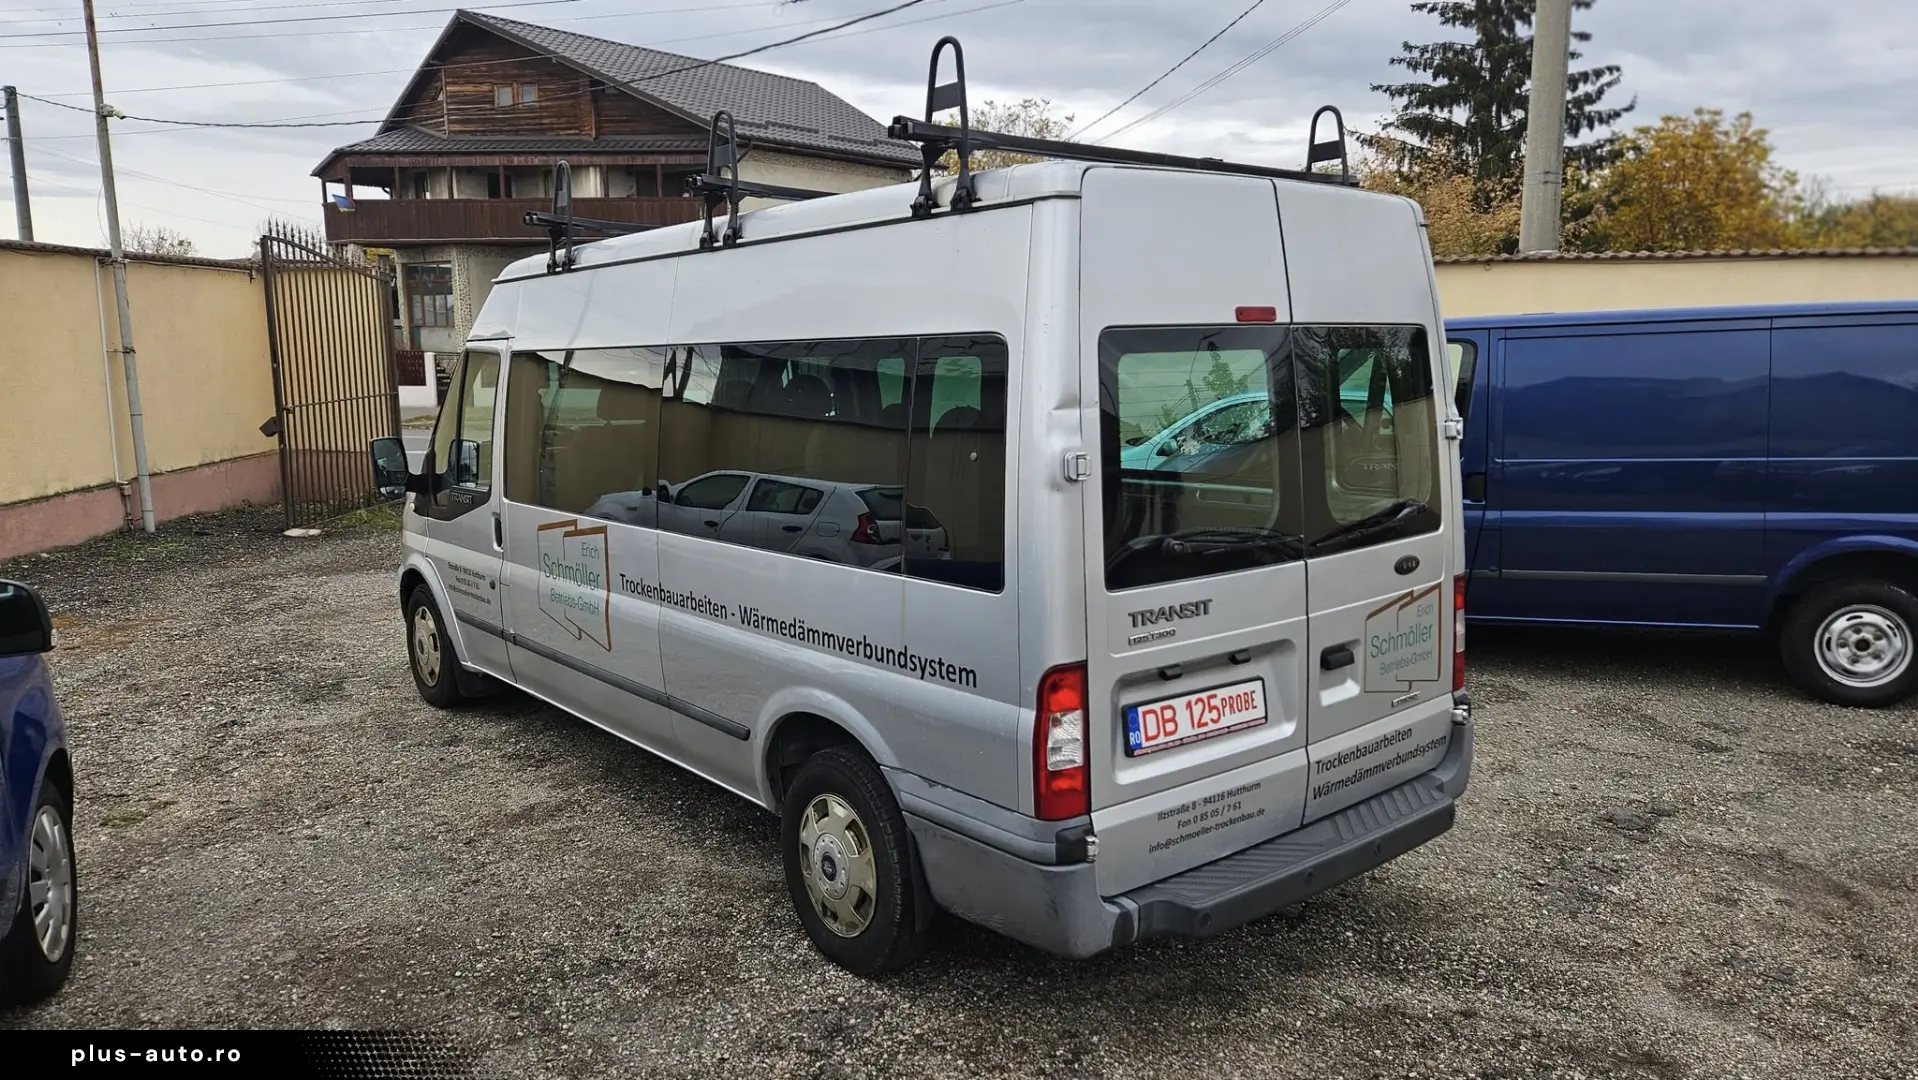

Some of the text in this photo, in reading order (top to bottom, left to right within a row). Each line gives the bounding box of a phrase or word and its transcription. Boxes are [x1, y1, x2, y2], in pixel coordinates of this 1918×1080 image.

[451, 492, 473, 505] TRANSIT
[581, 541, 600, 559] Erich
[543, 553, 601, 591] Schmöller
[550, 588, 600, 616] Betriebs-GmbH
[1128, 598, 1213, 628] TRANSIT
[619, 573, 728, 620] Trockenbauarbeiten
[738, 604, 977, 688] Wärmedämmverbundsystem
[1370, 623, 1433, 658] Schmöller
[1380, 648, 1433, 675] Betriebs-GmbH
[1141, 704, 1178, 742] DB
[1185, 693, 1221, 730] 125
[1221, 690, 1257, 717] PROBE
[1129, 731, 1141, 745] RO
[1315, 728, 1412, 775] Trockenbauarbeiten
[1313, 735, 1447, 800] Wärmedämmverbundsystem
[1157, 804, 1190, 821] Ilzstraße
[1226, 782, 1261, 799] Hutthurm
[1148, 808, 1265, 853] info@schmoeller-trockenbau.de
[1177, 817, 1192, 830] Fon
